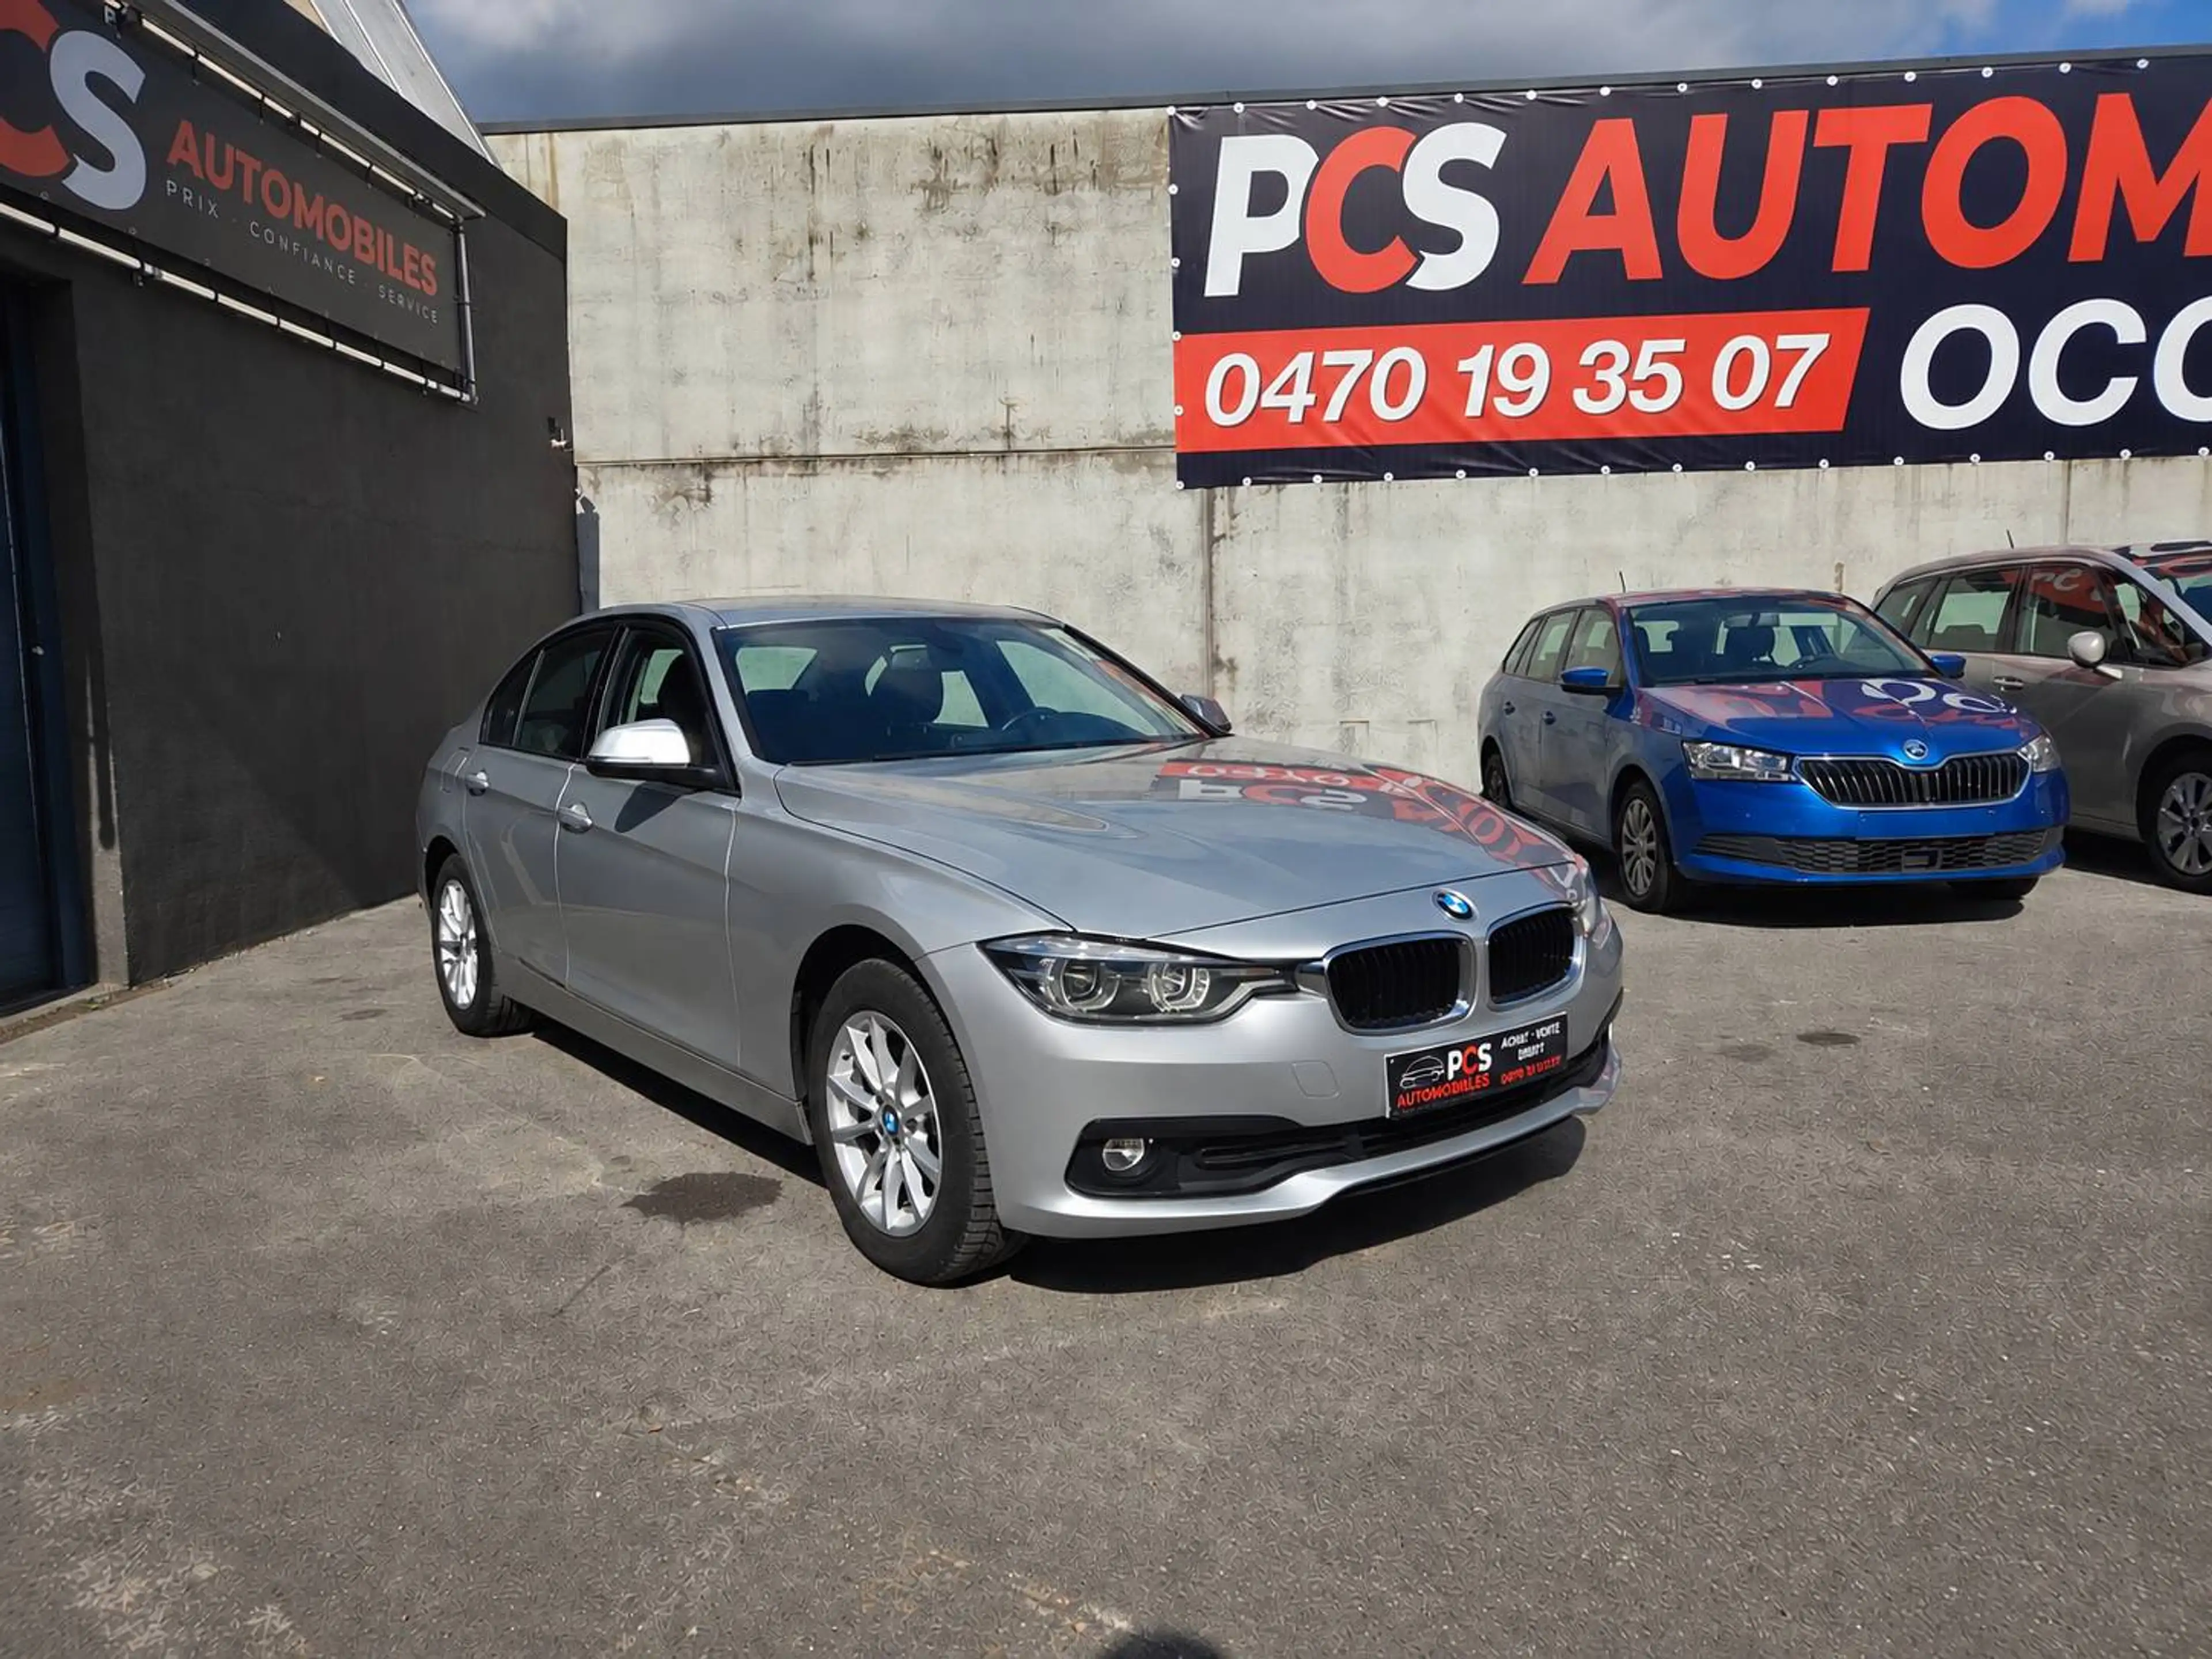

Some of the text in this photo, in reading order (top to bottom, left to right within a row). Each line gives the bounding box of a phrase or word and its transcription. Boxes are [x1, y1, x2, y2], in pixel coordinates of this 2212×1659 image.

[166, 180, 438, 324] PRIX CONFIANCE SERVICE
[167, 120, 438, 297] AUTOMOBILES
[1203, 92, 2212, 297] PCS AUTOM
[1205, 333, 1830, 427] 0470 19 35 07
[1447, 1043, 1493, 1081] PCS
